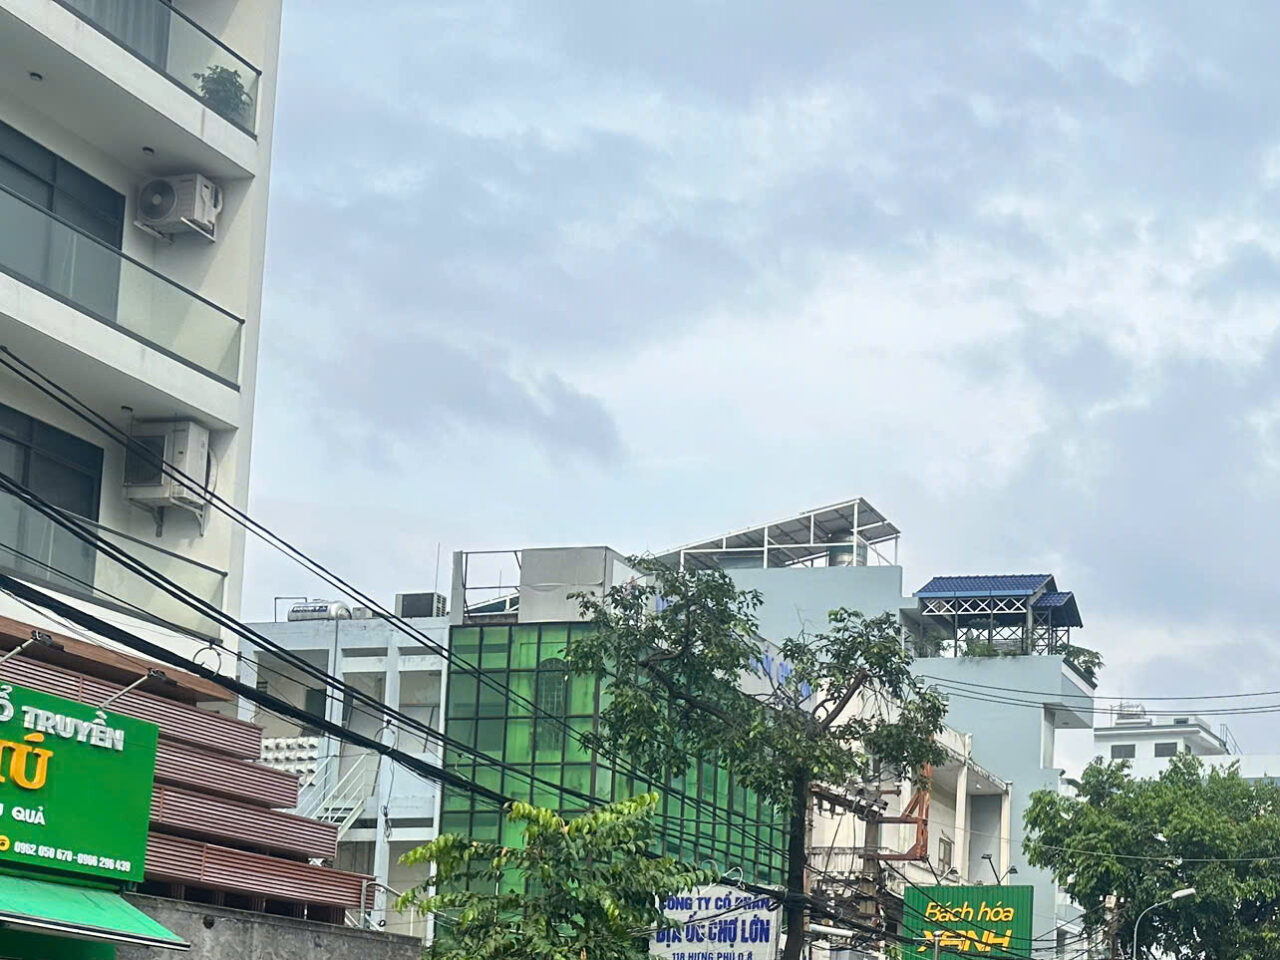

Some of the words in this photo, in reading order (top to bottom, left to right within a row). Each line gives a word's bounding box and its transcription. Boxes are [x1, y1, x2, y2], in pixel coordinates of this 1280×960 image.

[21, 706, 125, 751] TRUYỀN
[11, 806, 46, 825] QUẢ
[697, 897, 712, 910] TY
[714, 891, 732, 910] CỔ
[925, 901, 974, 922] Bách
[977, 901, 1015, 922] hóa
[708, 918, 739, 948] CHỢ
[740, 914, 770, 943] LỚN
[917, 930, 1013, 952] XANH
